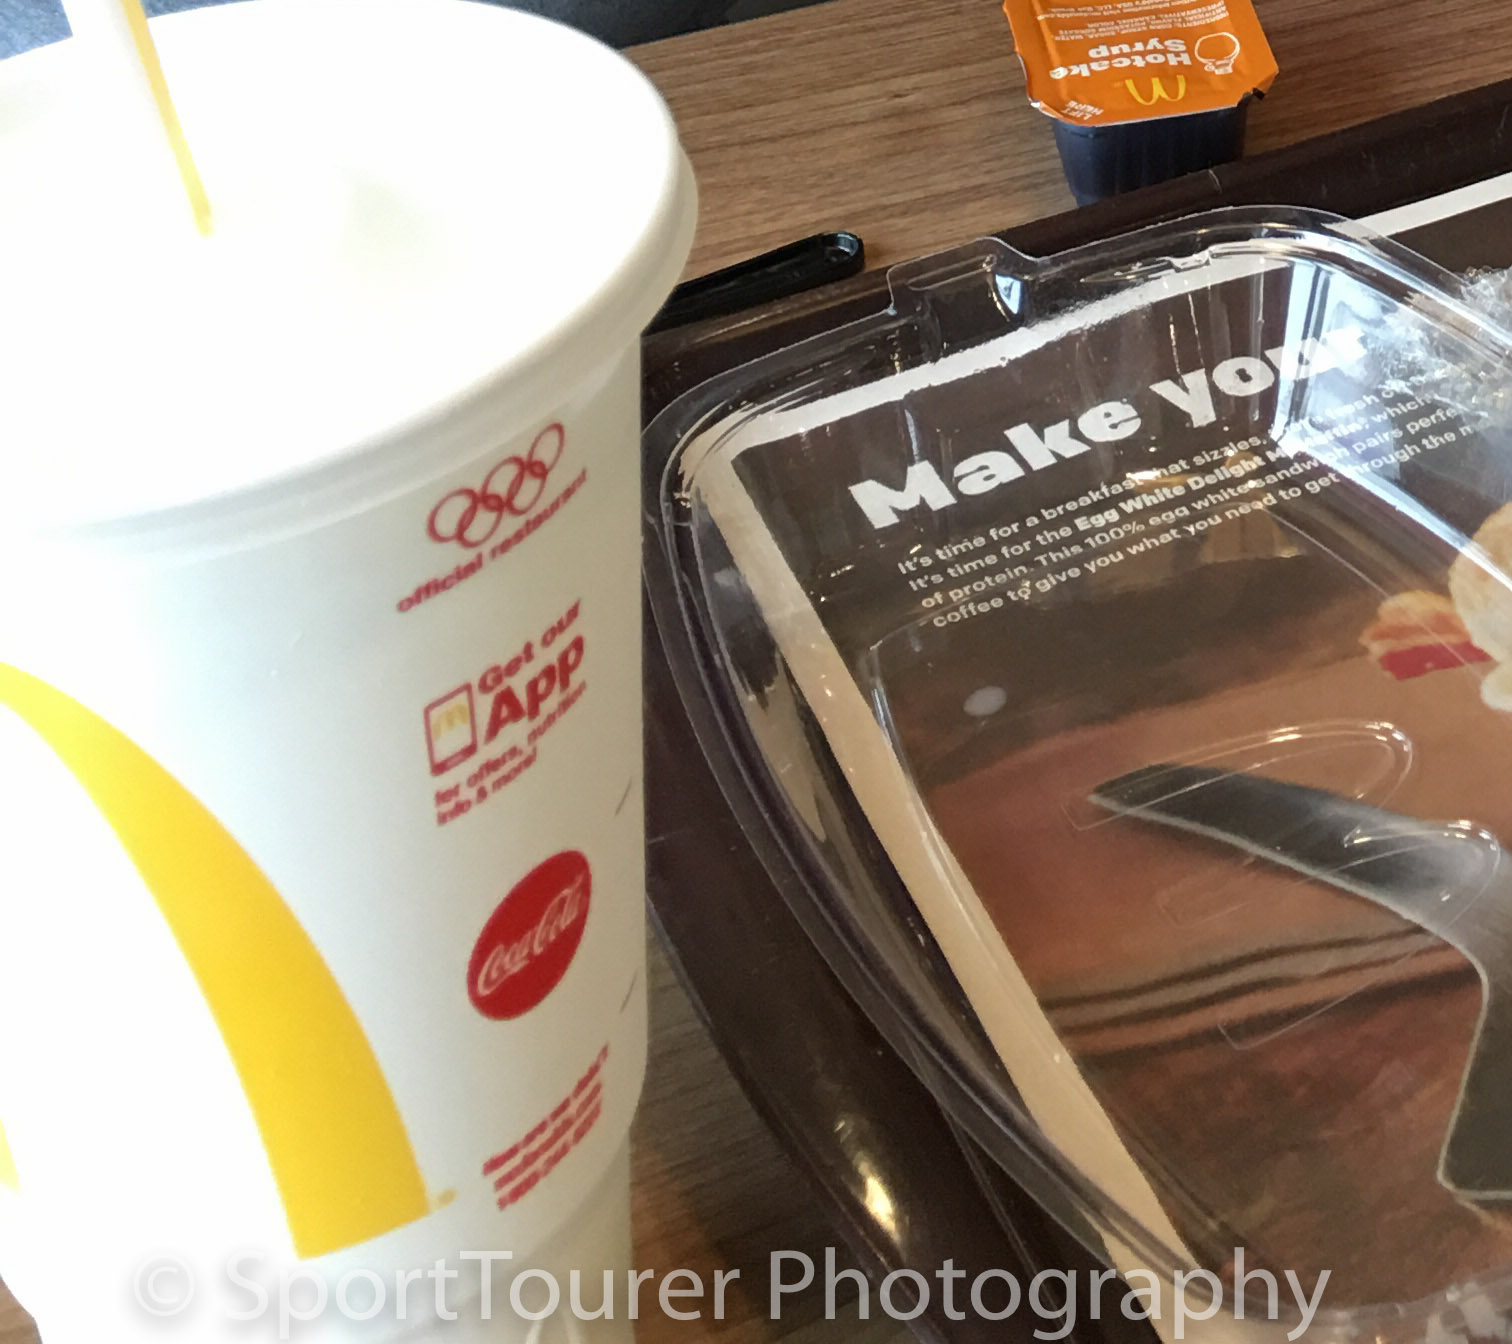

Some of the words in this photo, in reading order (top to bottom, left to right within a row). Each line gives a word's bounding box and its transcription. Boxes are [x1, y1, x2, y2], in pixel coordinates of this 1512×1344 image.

[1049, 53, 1193, 80] Hotcake
[1088, 37, 1188, 59] Syrup
[1060, 108, 1093, 121] LIFT
[1064, 99, 1104, 116] HERE
[847, 399, 1143, 530] Make
[897, 554, 933, 575] It's
[935, 534, 987, 558] time
[989, 521, 1021, 541] for
[1025, 515, 1040, 529] a
[1040, 475, 1145, 521] breakfast
[1192, 435, 1268, 467] sizzles.
[921, 591, 944, 610] of
[948, 564, 1035, 604] protein.
[1034, 543, 1084, 568] This
[1084, 520, 1146, 550] 100%
[1148, 505, 1191, 529] egg
[1191, 485, 1248, 512] white
[1351, 430, 1404, 455] pairs
[1405, 408, 1460, 434] perfe
[908, 570, 945, 592] It's
[947, 554, 999, 579] time
[1000, 539, 1032, 561] for
[1035, 523, 1074, 545] the
[1073, 508, 1120, 533] Egg
[1118, 480, 1187, 517] White
[1189, 452, 1266, 492] Delight
[932, 596, 1004, 628] coffee
[1006, 585, 1033, 602] to
[1034, 567, 1083, 594] give
[1083, 550, 1125, 575] you
[1126, 526, 1182, 555] what
[1182, 513, 1222, 536] you
[1224, 492, 1278, 520] need
[1278, 485, 1303, 502] to
[1304, 470, 1341, 495] get
[1340, 442, 1420, 478] hrough
[1422, 432, 1457, 451] the
[478, 640, 535, 694] Get
[484, 634, 585, 745] App
[466, 745, 523, 788] offers,
[477, 869, 586, 998] Coca-Cola
